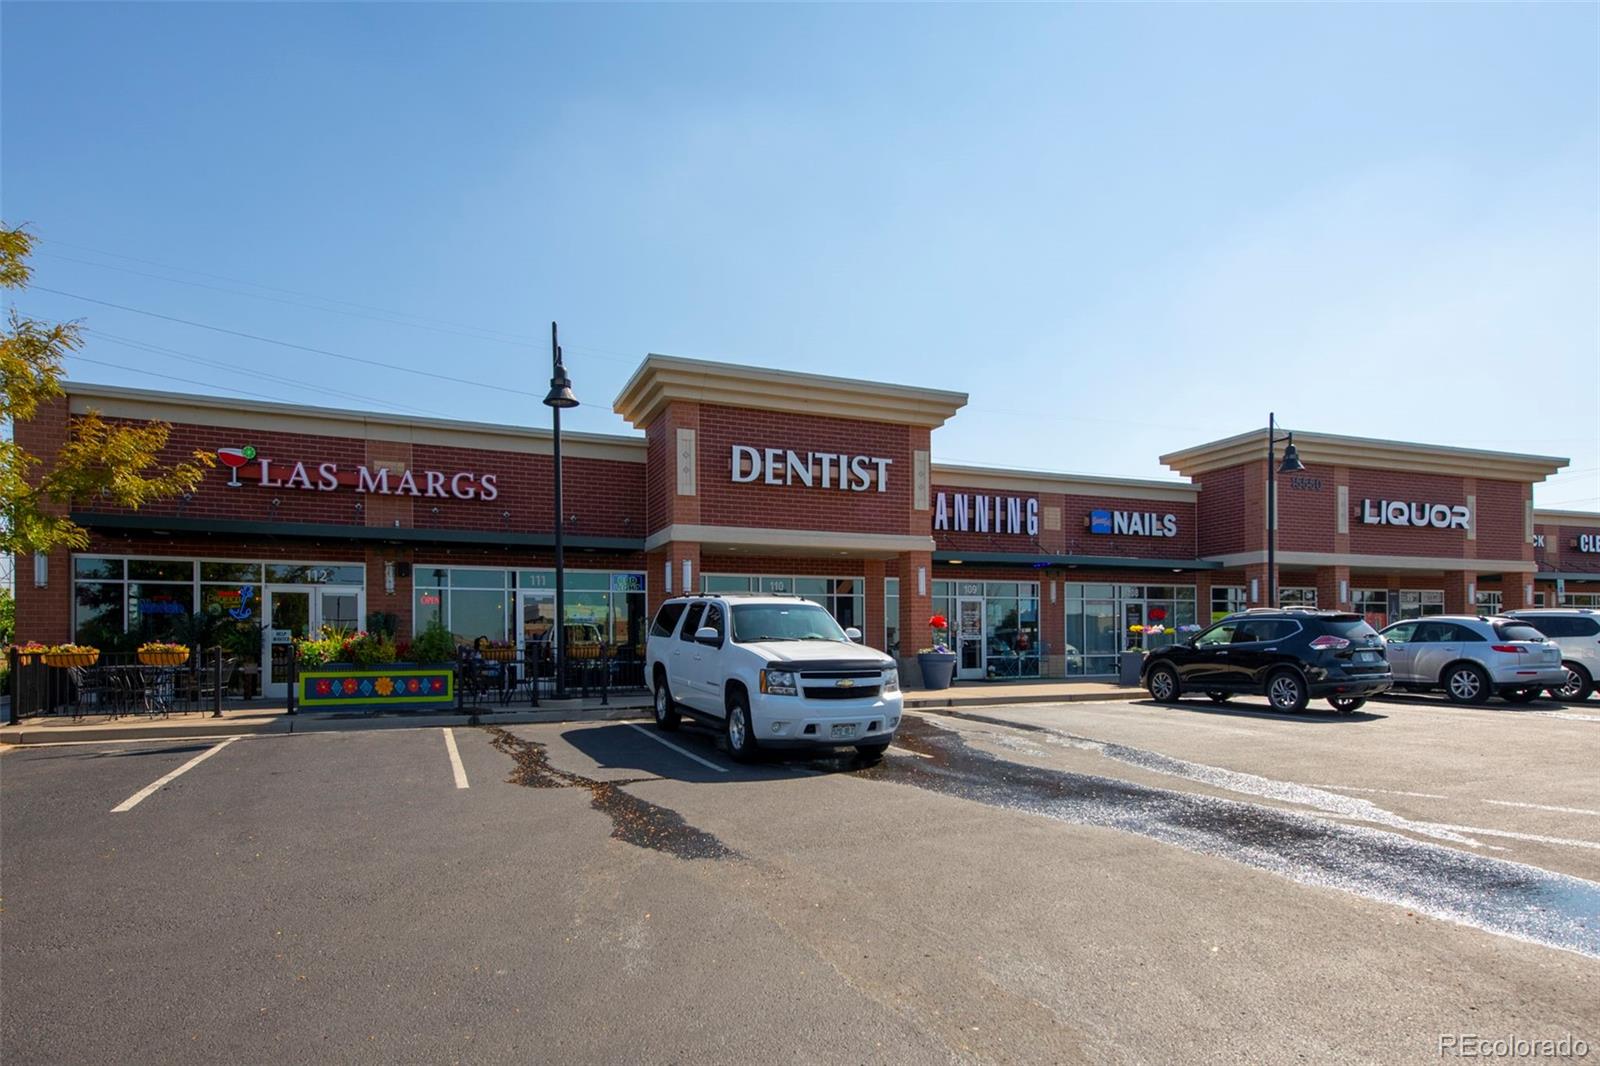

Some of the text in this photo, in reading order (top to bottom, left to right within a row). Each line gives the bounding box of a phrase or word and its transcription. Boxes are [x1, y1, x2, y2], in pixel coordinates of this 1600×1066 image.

[258, 458, 498, 500] LAS MARGS
[732, 445, 893, 492] DENTIST
[934, 492, 1038, 536] ANNING
[1113, 511, 1177, 537] NAILS
[1363, 498, 1470, 529] LIQUOR
[305, 569, 327, 582] 112
[529, 575, 546, 586] 111
[770, 581, 784, 591] 110
[964, 584, 977, 594] 109
